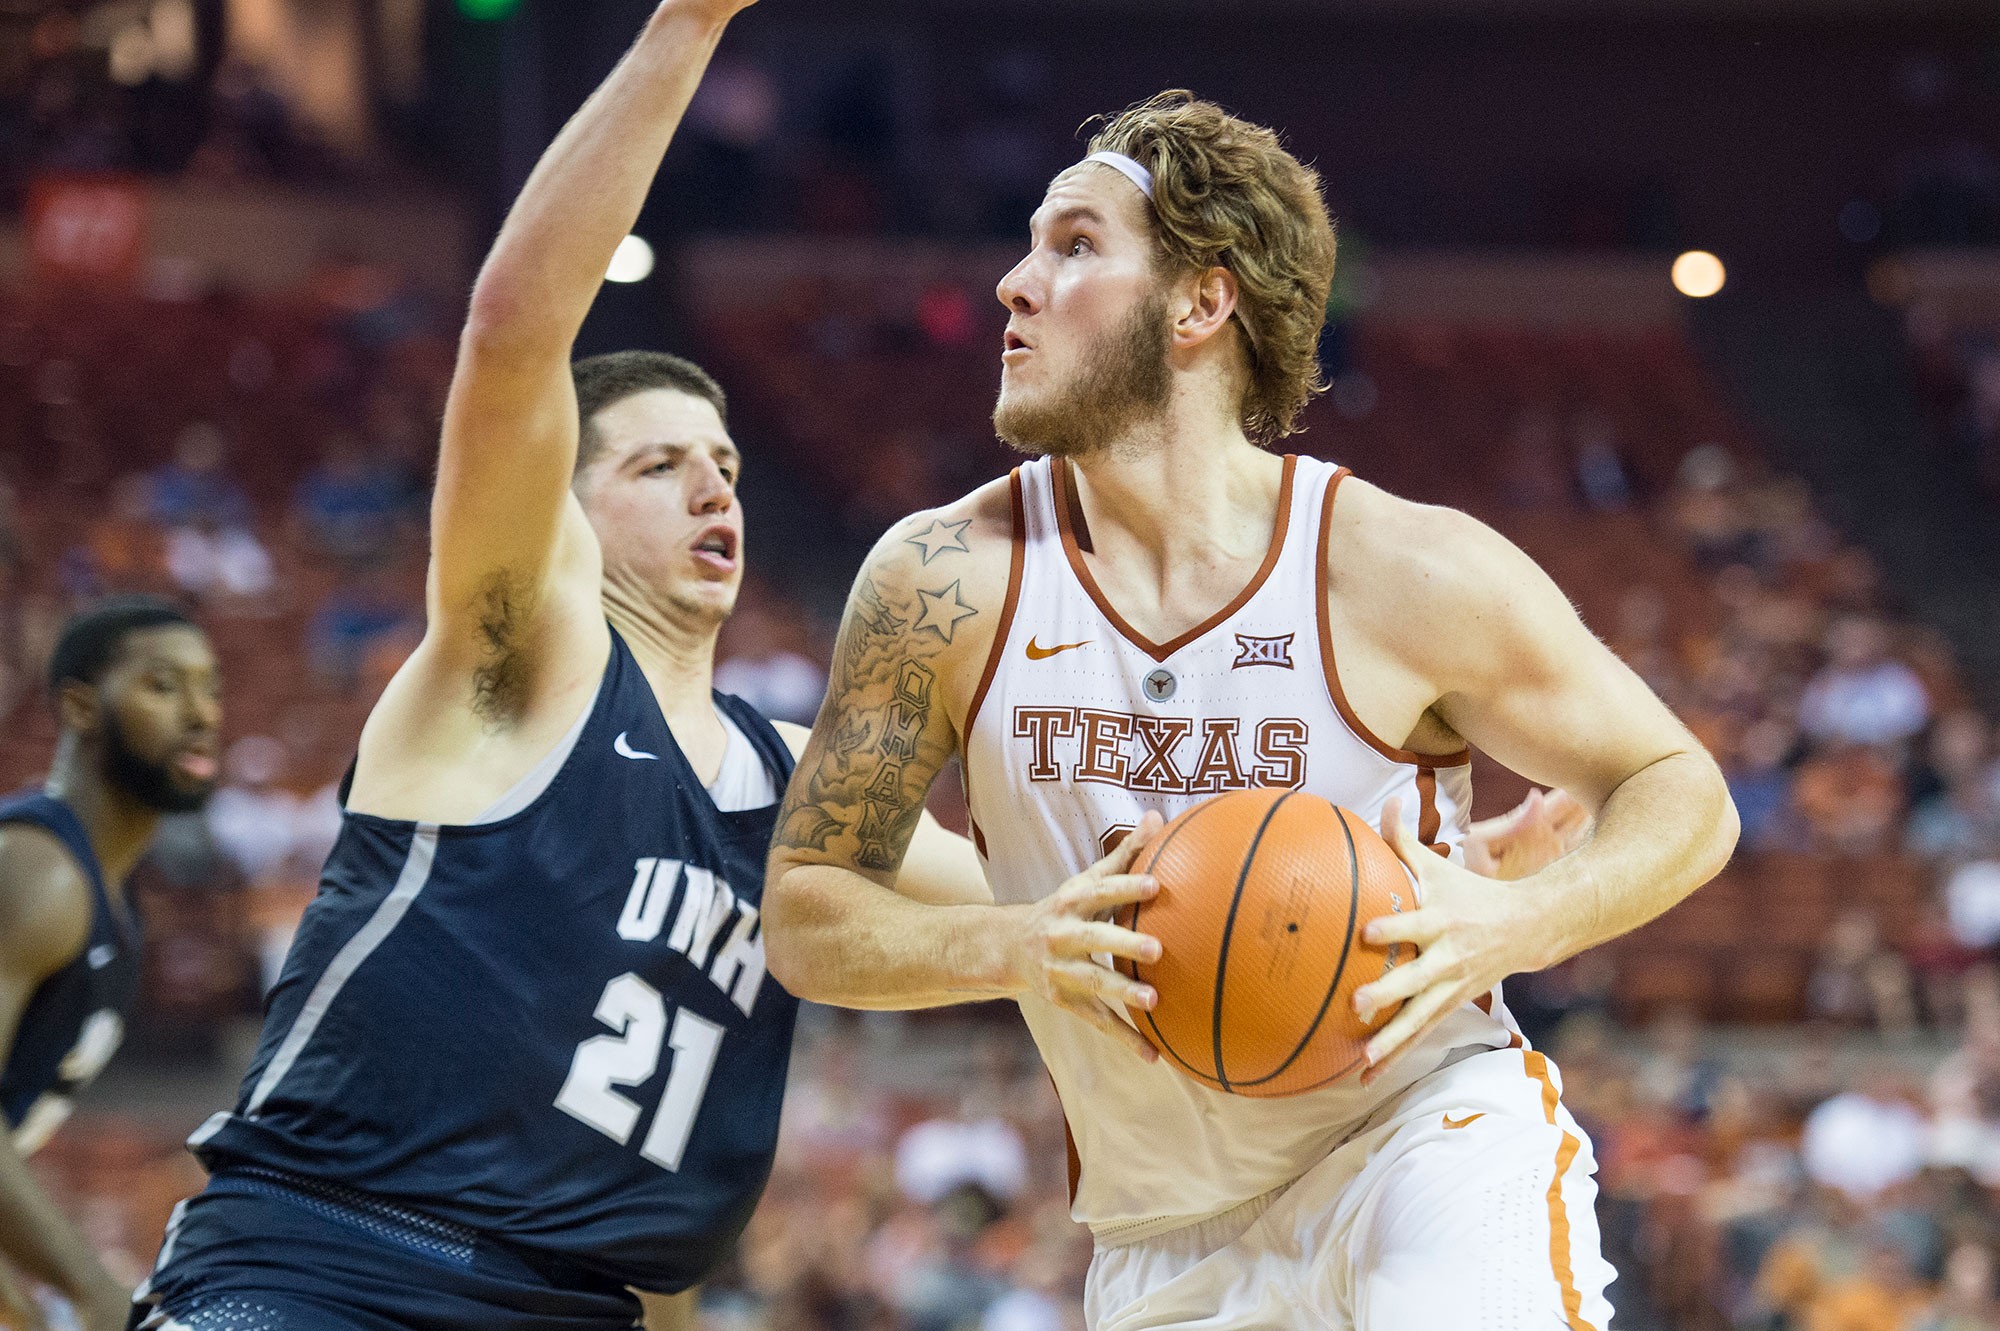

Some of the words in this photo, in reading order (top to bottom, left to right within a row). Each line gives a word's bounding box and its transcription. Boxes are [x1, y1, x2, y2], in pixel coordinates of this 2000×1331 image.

[1234, 634, 1293, 668] XII
[854, 659, 935, 869] OHANA
[1013, 705, 1308, 794] TEXAS
[616, 857, 767, 1018] UNH
[552, 971, 726, 1173] 21
